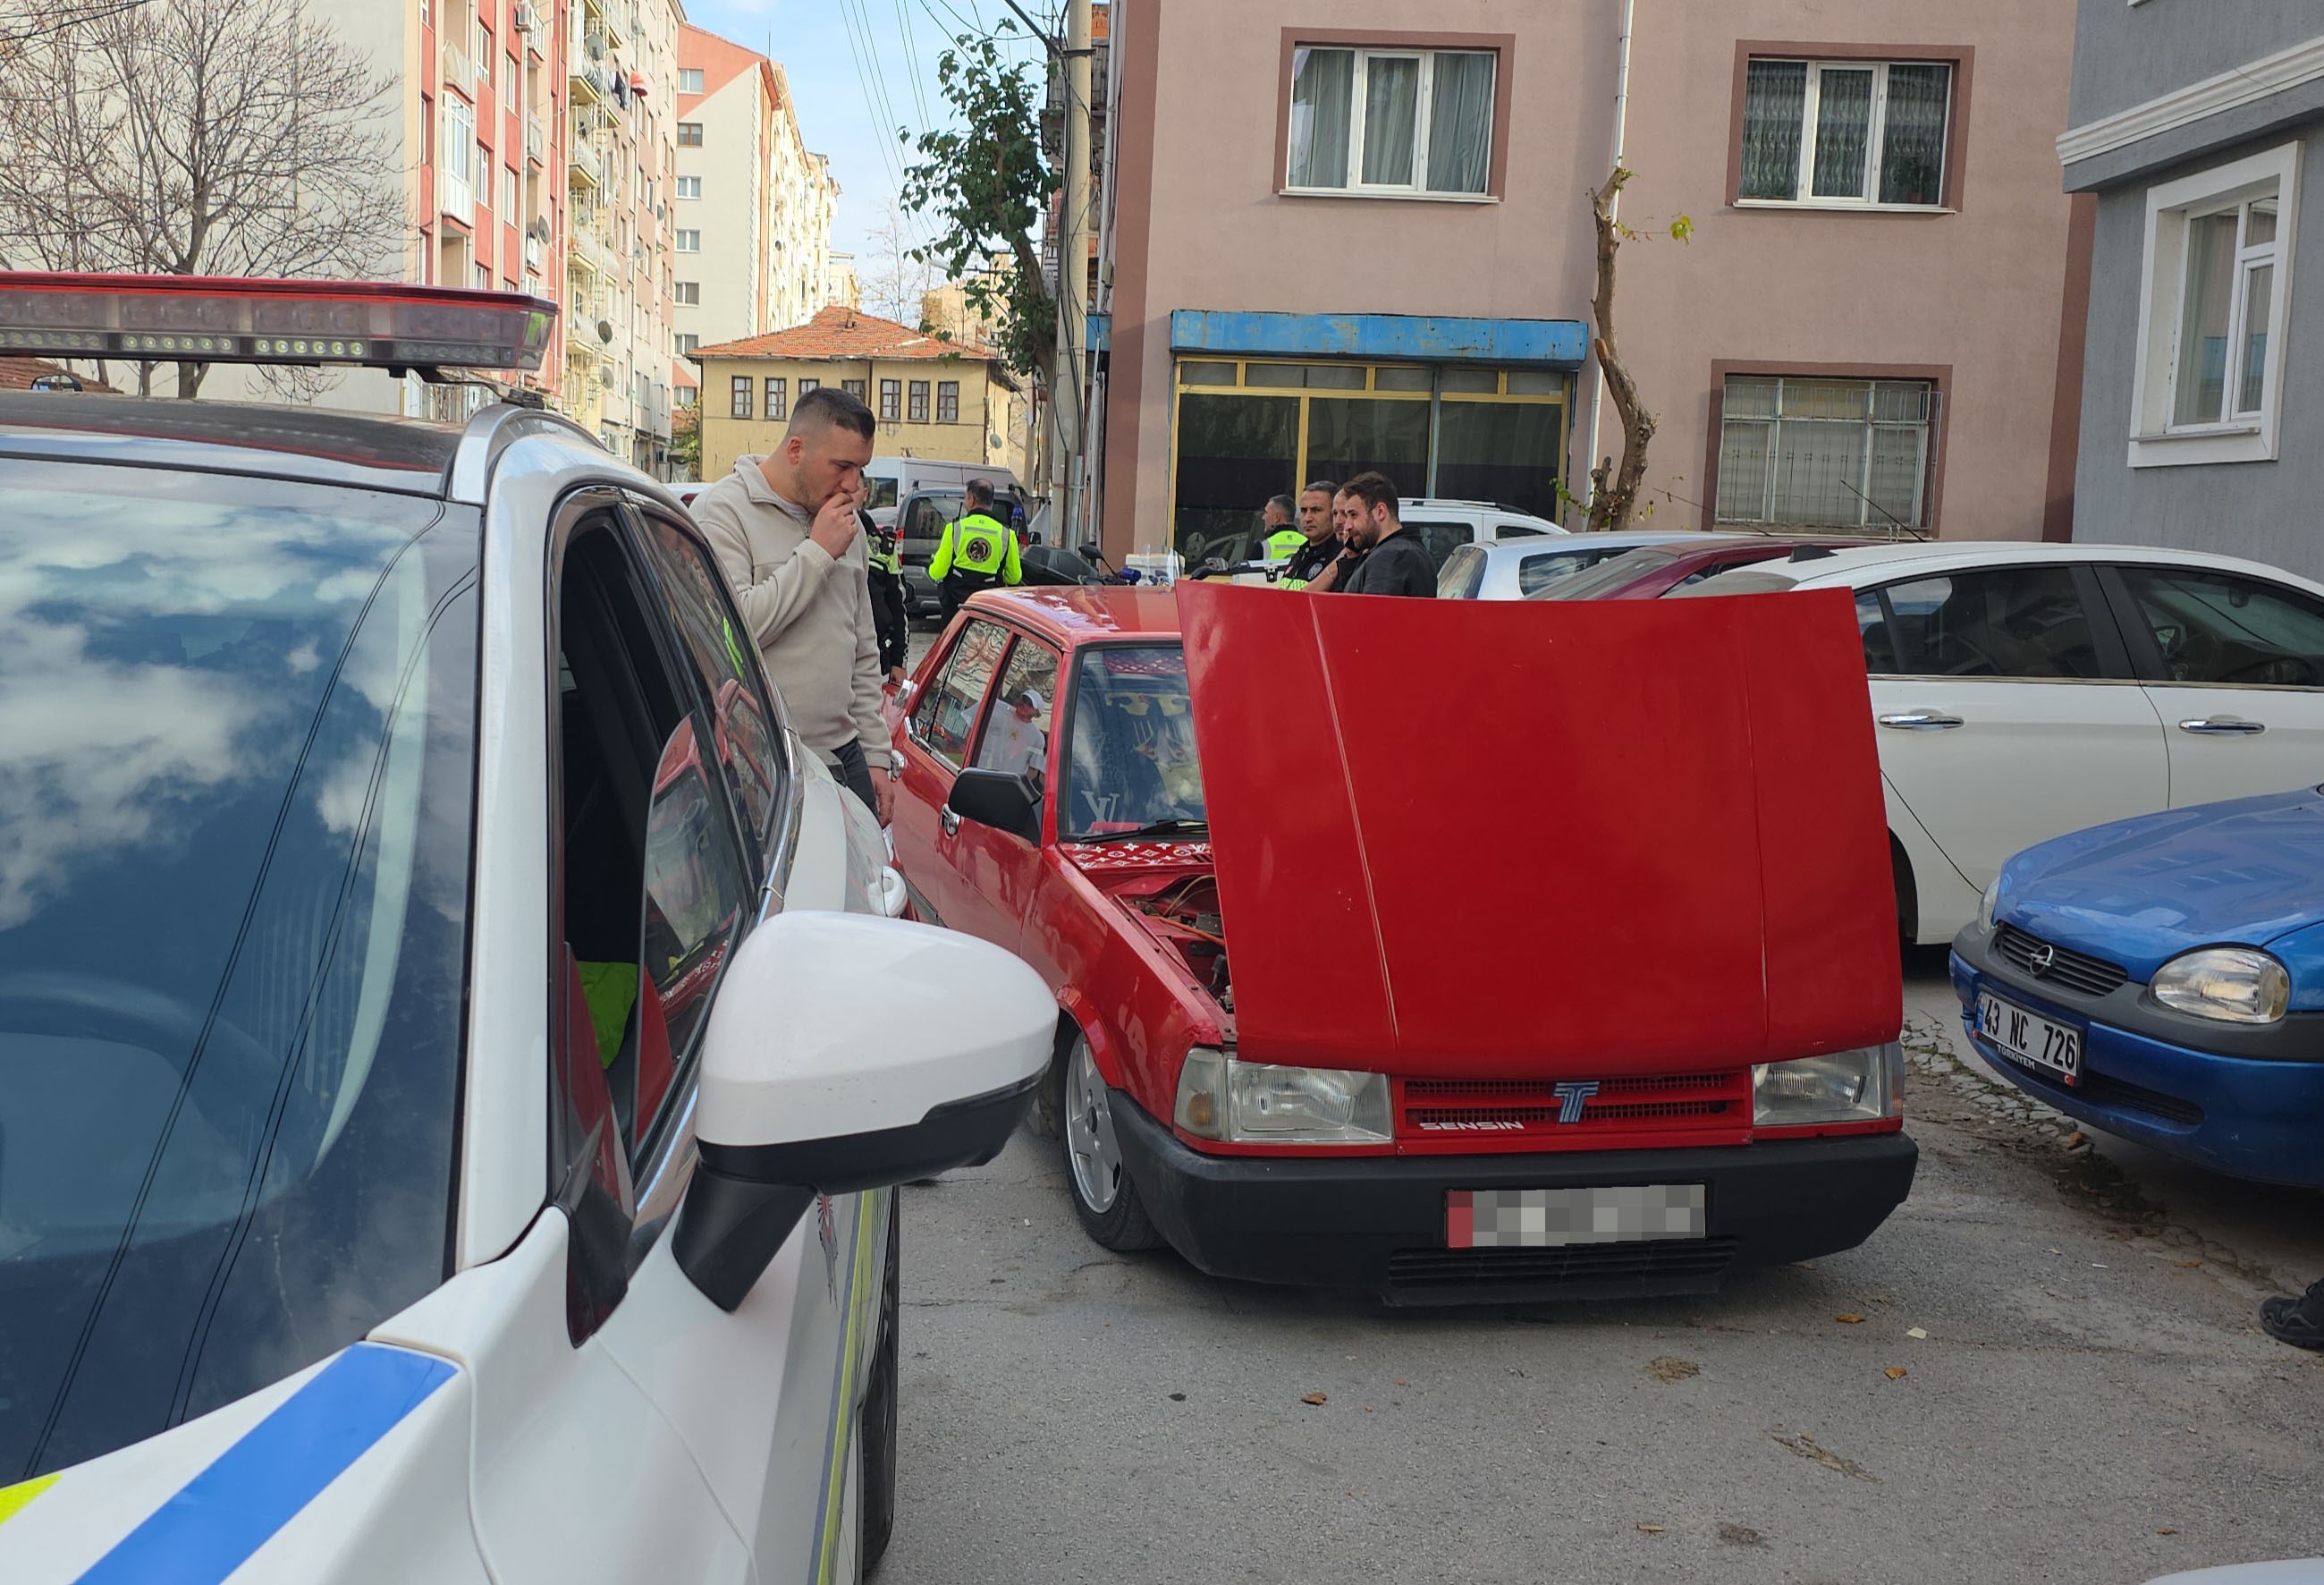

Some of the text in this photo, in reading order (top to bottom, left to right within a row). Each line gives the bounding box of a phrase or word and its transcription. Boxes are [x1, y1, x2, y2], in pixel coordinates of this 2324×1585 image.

[1985, 999, 2075, 1070] 43 NC 726
